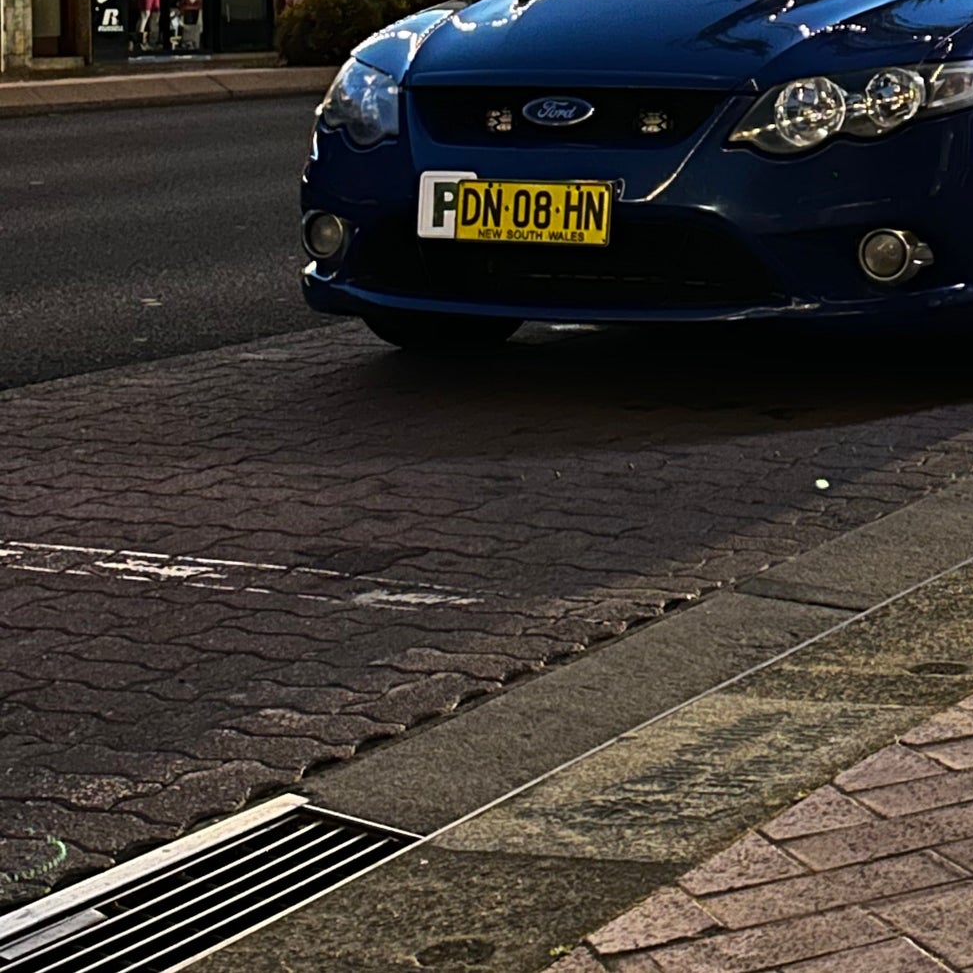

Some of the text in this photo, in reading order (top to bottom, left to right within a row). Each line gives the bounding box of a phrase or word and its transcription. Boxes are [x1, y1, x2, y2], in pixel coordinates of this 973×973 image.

[537, 101, 576, 119] Ford
[433, 182, 457, 227] P
[478, 229, 585, 242] NEW SOUTH WALES
